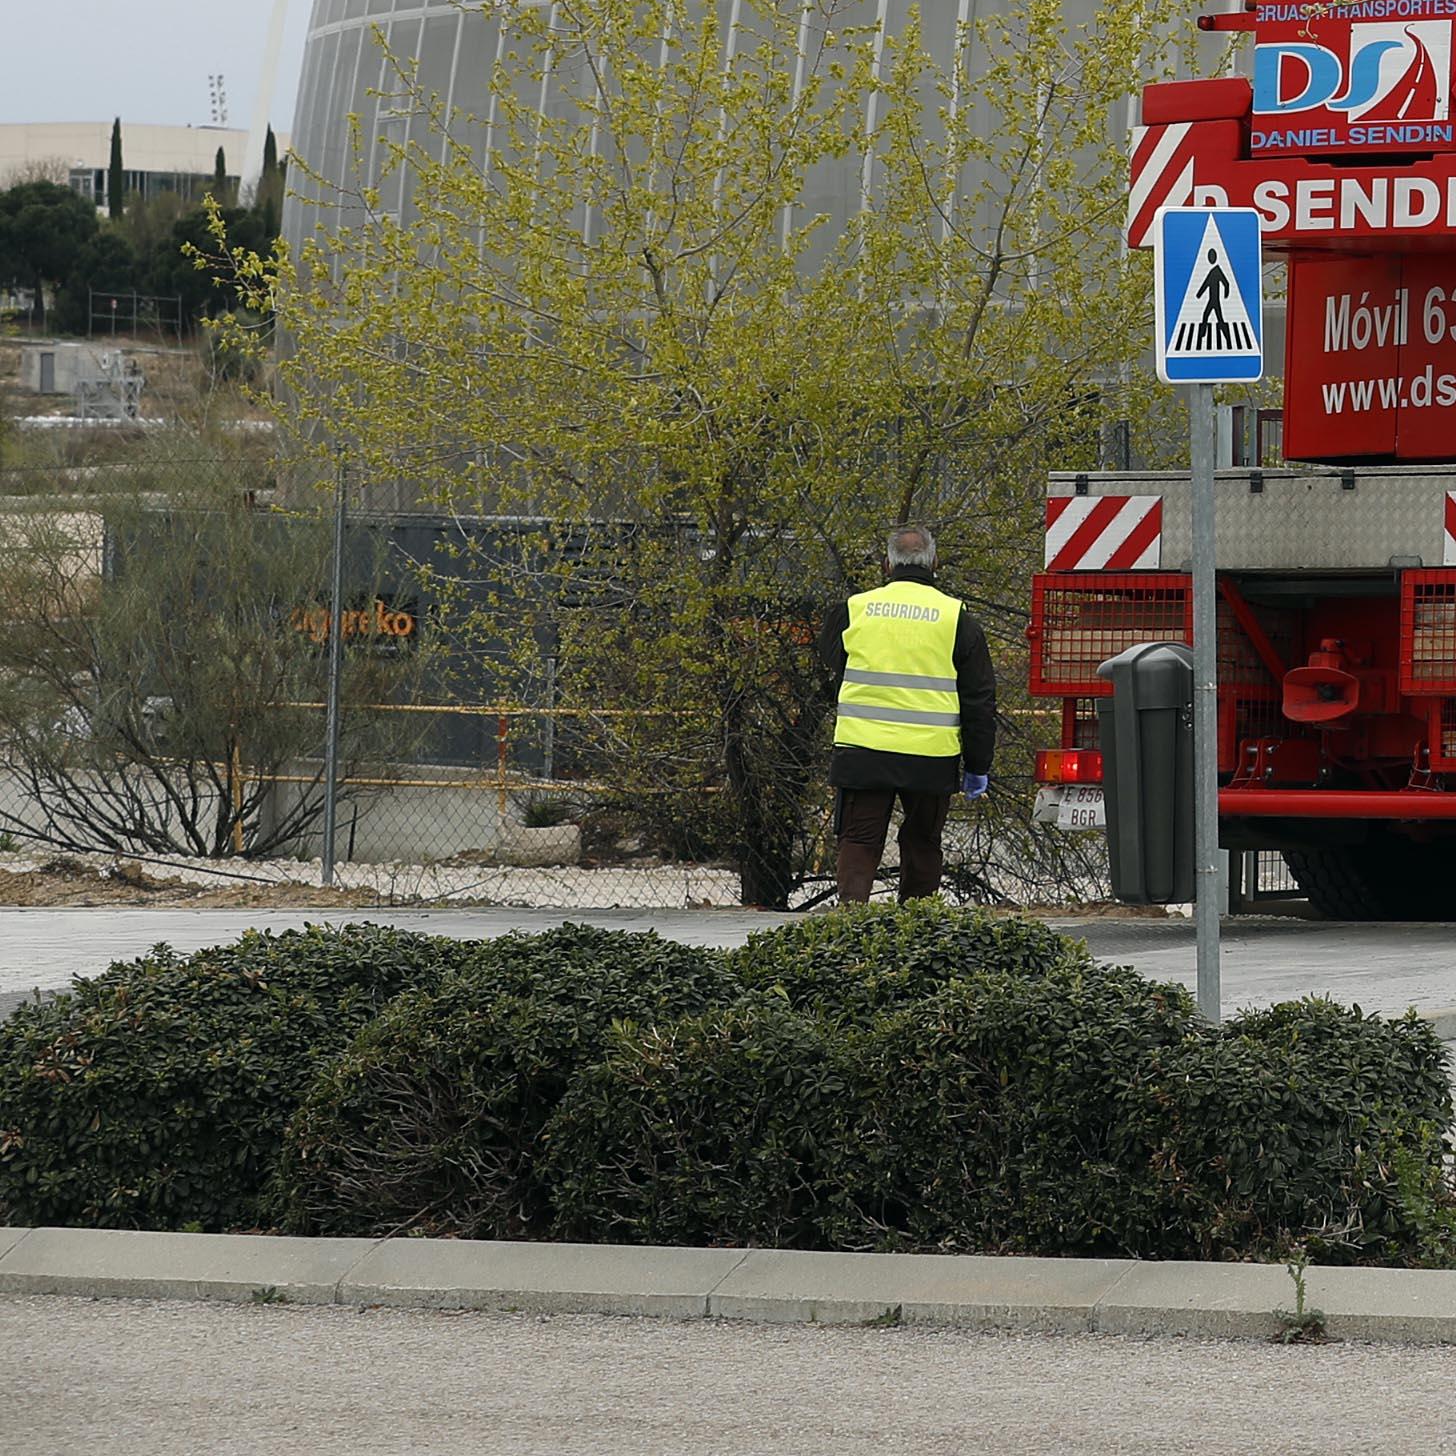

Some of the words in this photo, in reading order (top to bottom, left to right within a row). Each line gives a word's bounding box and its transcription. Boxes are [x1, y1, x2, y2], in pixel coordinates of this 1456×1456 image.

[1250, 128, 1345, 149] DANIEL
[1348, 124, 1453, 144] SENDIN
[1324, 288, 1409, 353] Móvil
[865, 602, 940, 623] SEGURIDAD
[1077, 786, 1105, 803] 856
[1071, 808, 1097, 826] BGR
